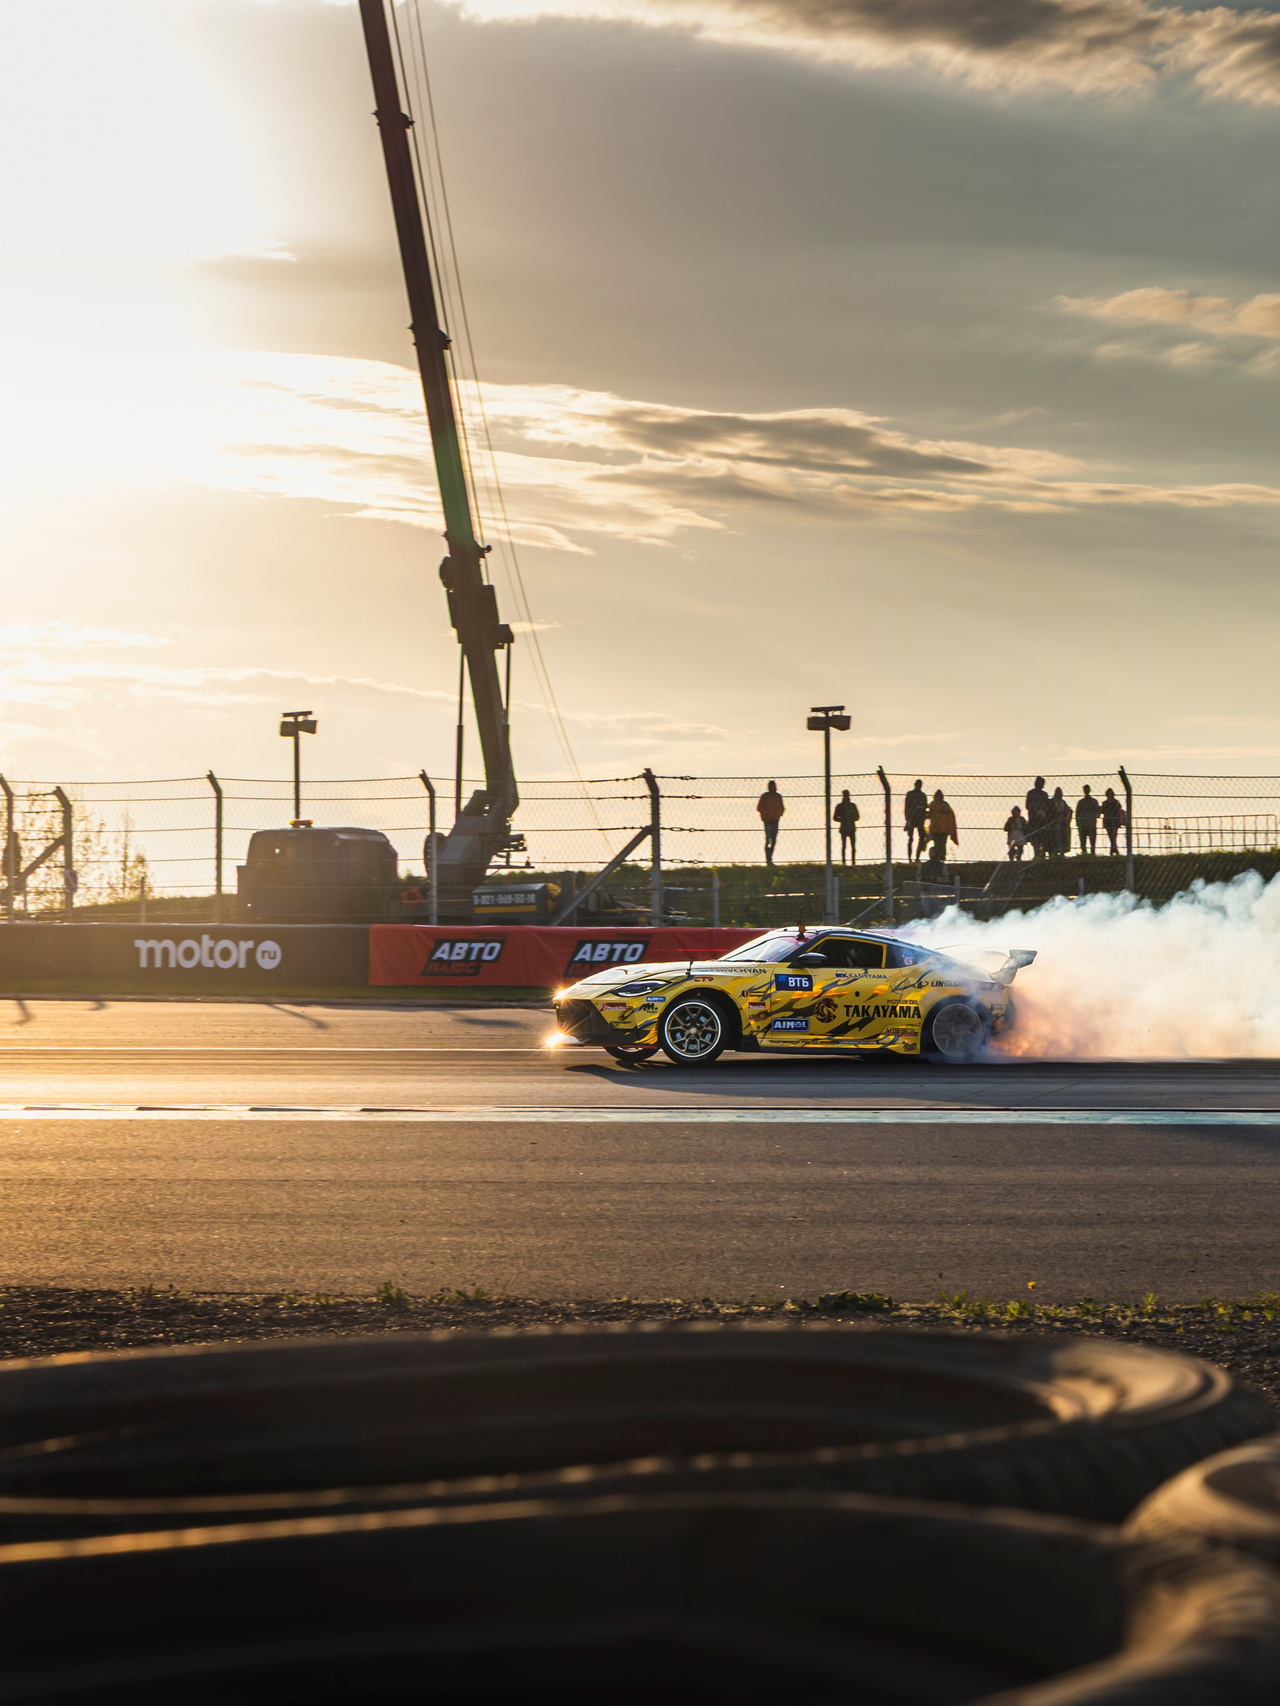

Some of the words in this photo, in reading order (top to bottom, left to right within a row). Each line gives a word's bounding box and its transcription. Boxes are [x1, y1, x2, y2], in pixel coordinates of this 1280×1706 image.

[134, 934, 254, 969] motor
[432, 943, 502, 961] АВТО
[573, 943, 645, 962] АВТО
[788, 977, 810, 987] ВТБ
[843, 1004, 922, 1019] TAKAYAMA
[773, 1020, 807, 1029] AIMOL
